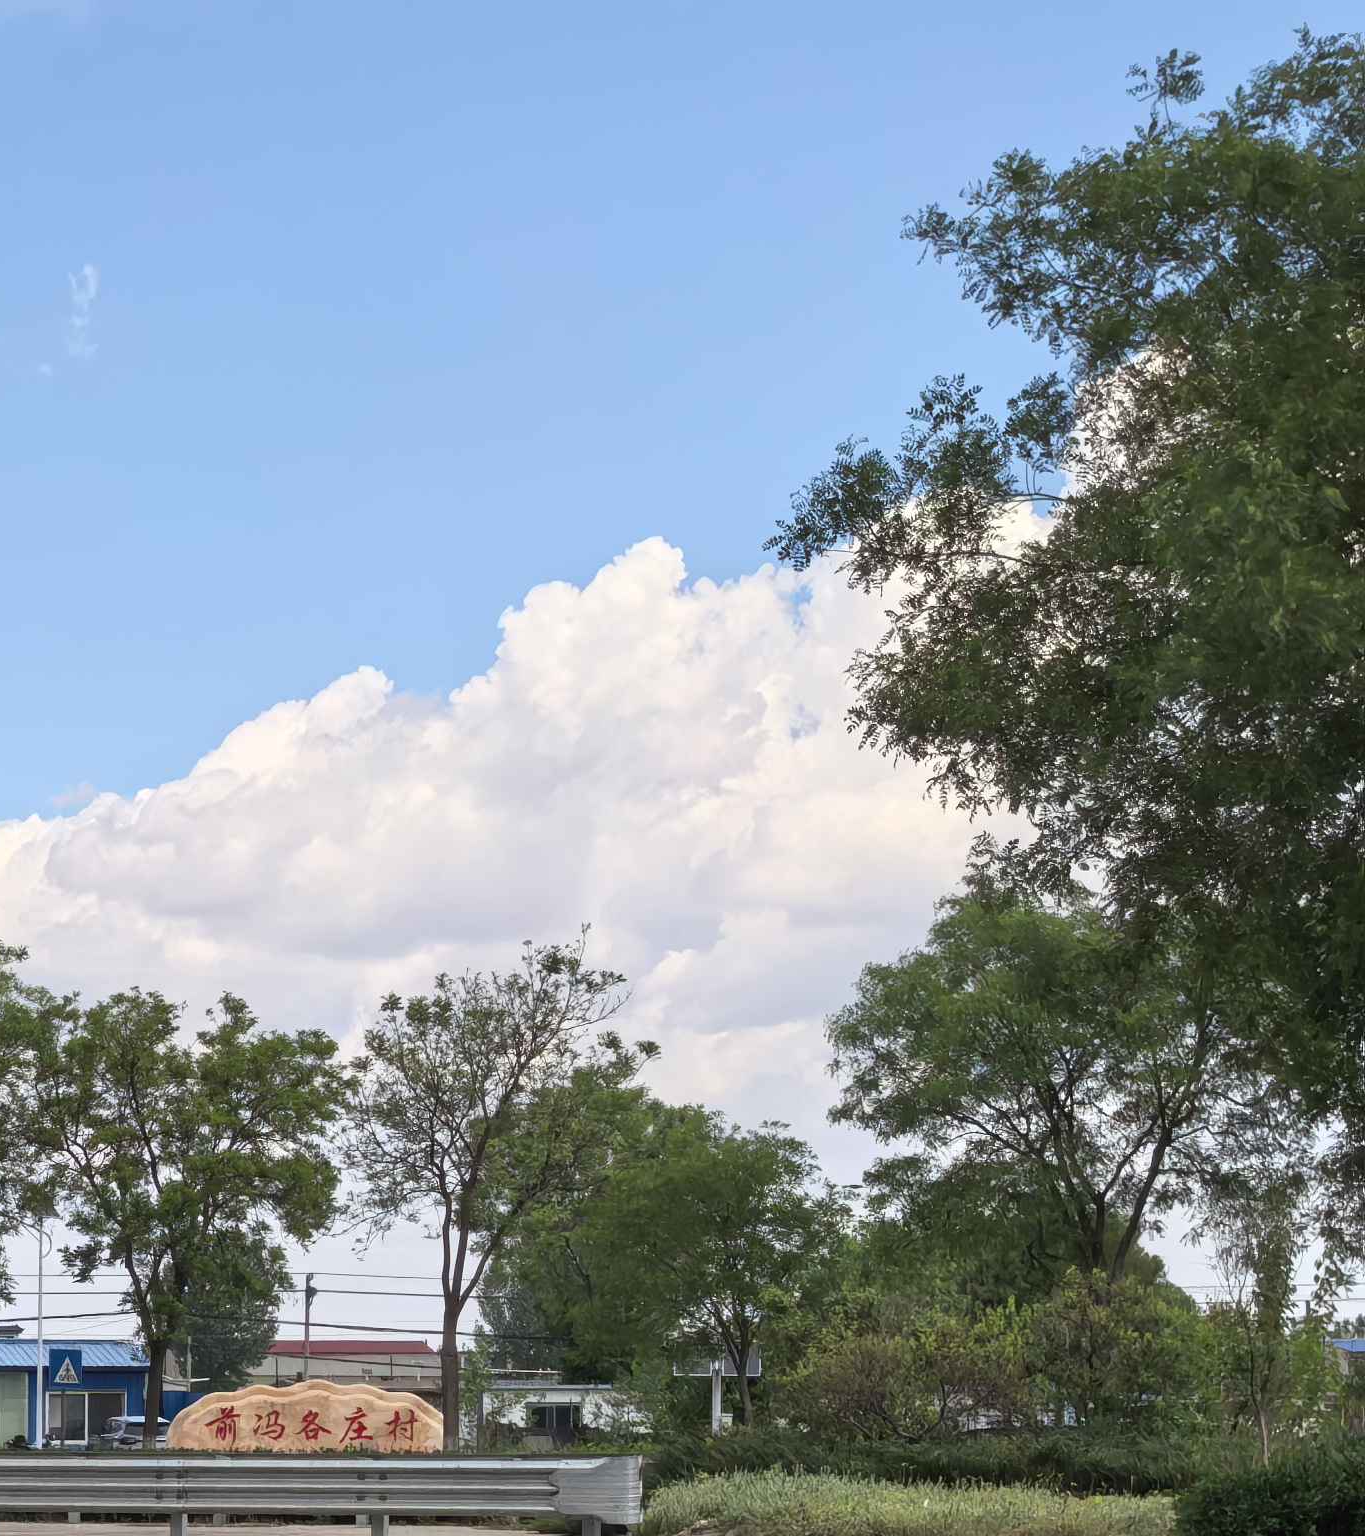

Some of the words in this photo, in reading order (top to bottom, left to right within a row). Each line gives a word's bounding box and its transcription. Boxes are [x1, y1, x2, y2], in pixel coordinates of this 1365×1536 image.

[205, 1407, 419, 1444] 前冯各庄村
